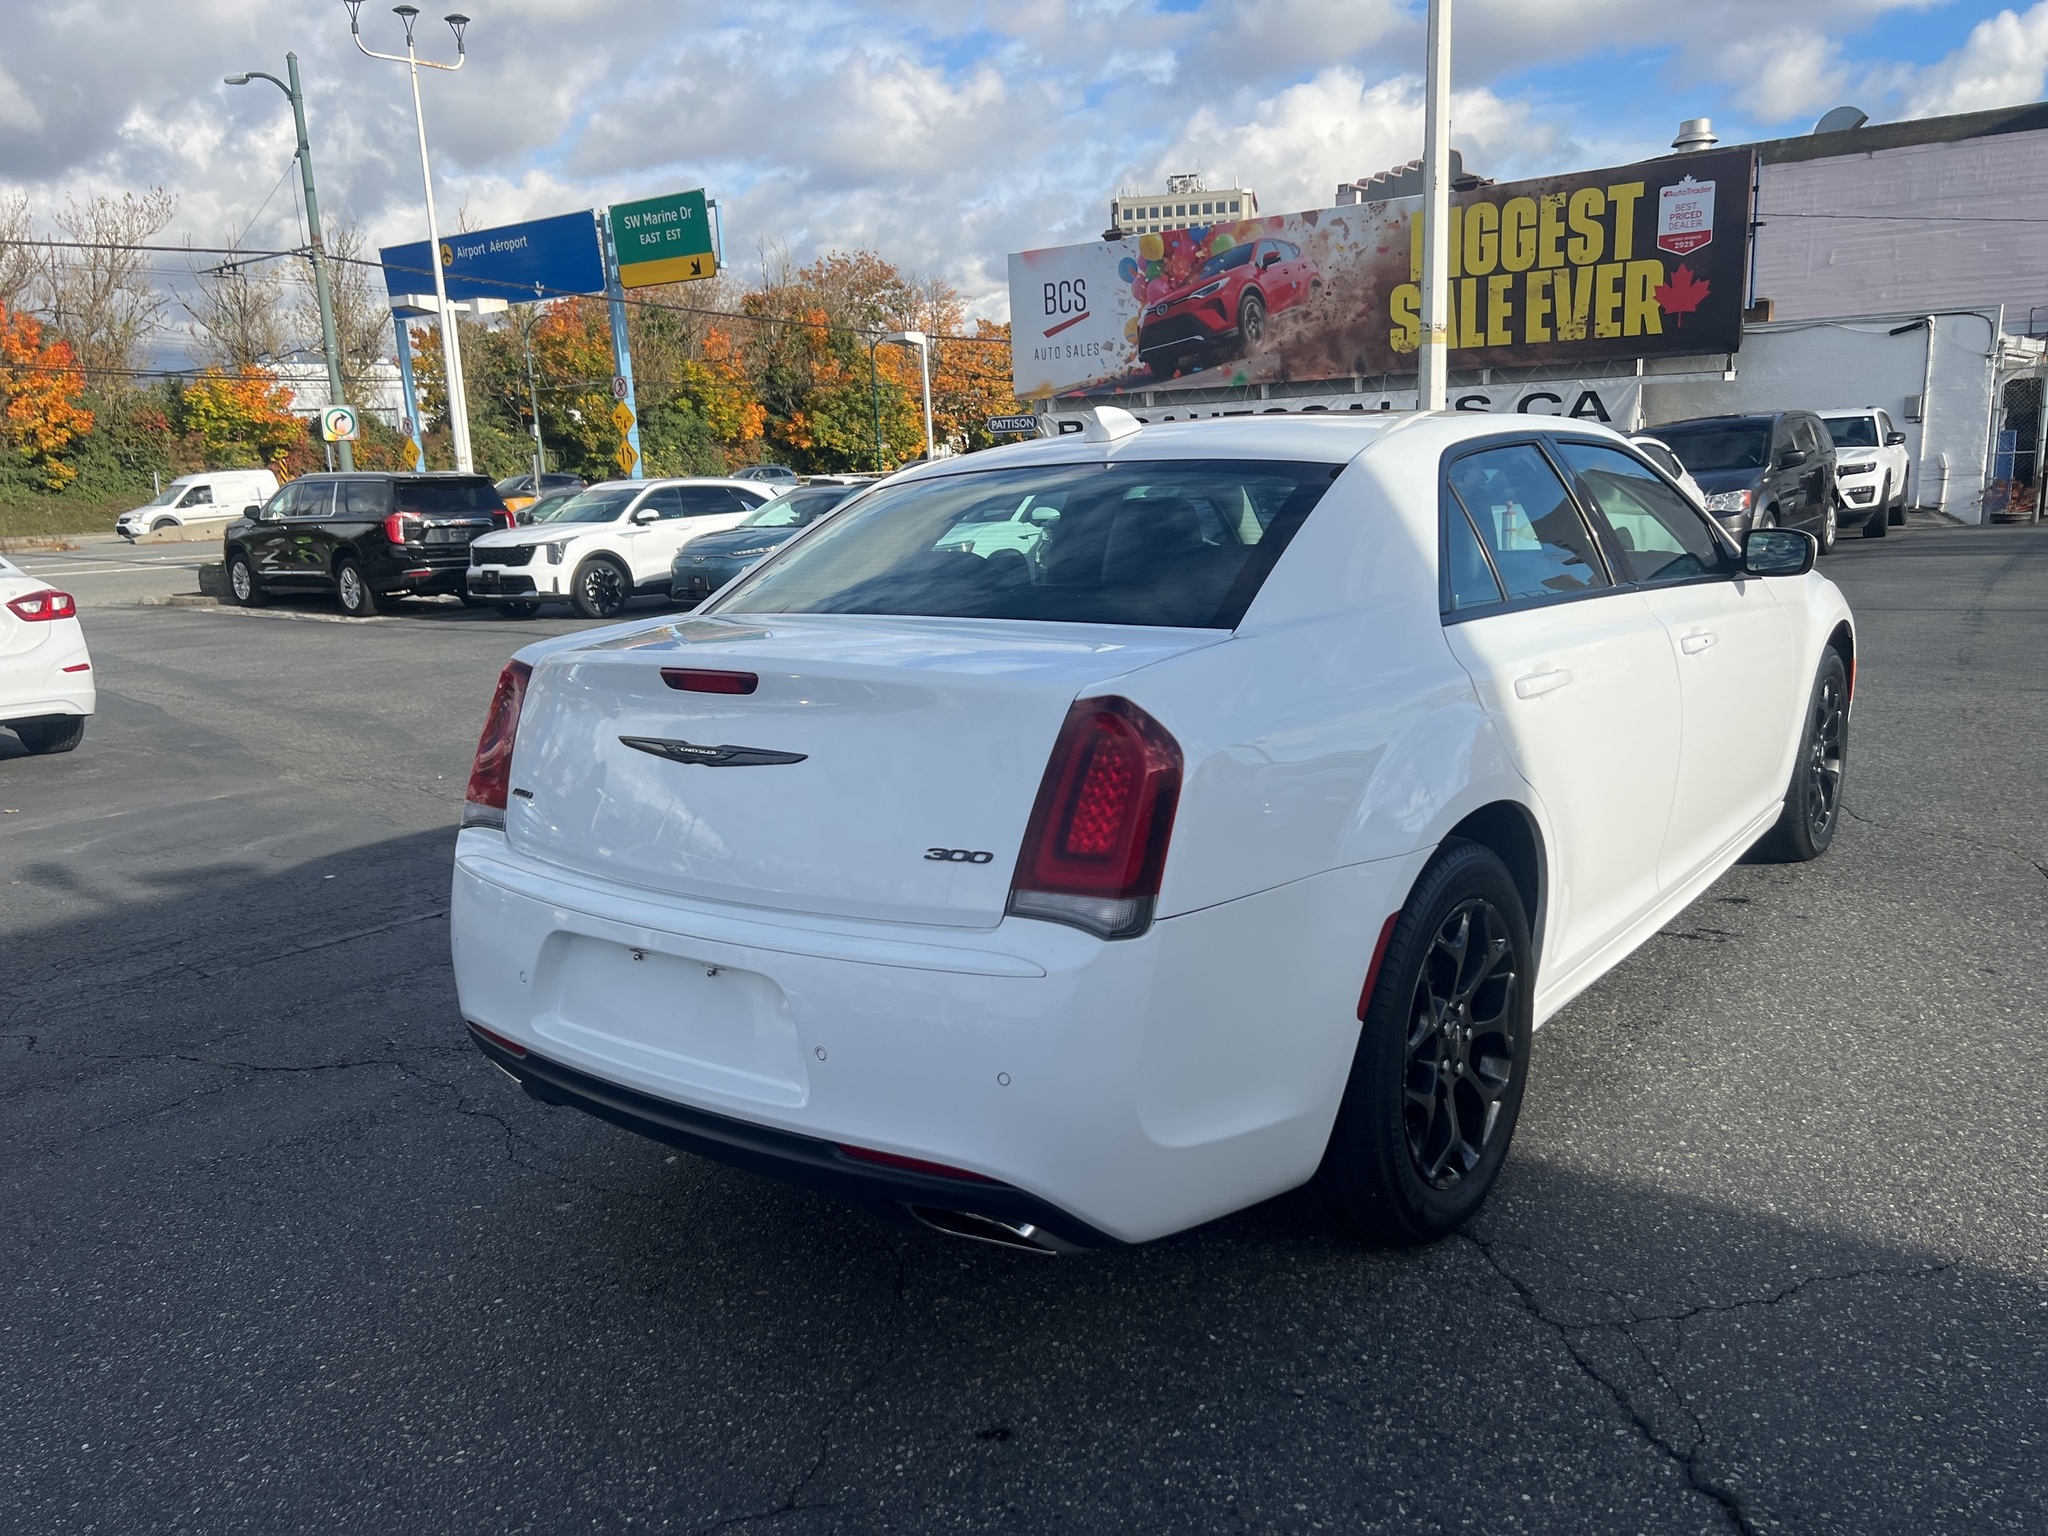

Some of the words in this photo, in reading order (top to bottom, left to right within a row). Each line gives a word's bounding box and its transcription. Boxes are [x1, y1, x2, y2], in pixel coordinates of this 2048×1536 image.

[1675, 202, 1697, 212] BEST
[624, 214, 641, 230] SW
[643, 210, 678, 226] Marine
[679, 206, 692, 220] Dr
[1670, 211, 1702, 221] PRICED
[1410, 181, 1645, 282] IGGEST
[1669, 220, 1703, 231] DEALER
[639, 231, 661, 245] EAST
[666, 228, 681, 241] EST
[1674, 240, 1694, 249] 2025
[456, 243, 486, 260] Airport
[490, 235, 528, 253] Aéroport
[1044, 278, 1086, 315] BCS
[1525, 259, 1665, 344] EVER
[1034, 346, 1061, 361] AUTO
[1066, 342, 1100, 358] SALES
[991, 417, 1035, 430] PATTISON
[923, 847, 994, 864] 300
